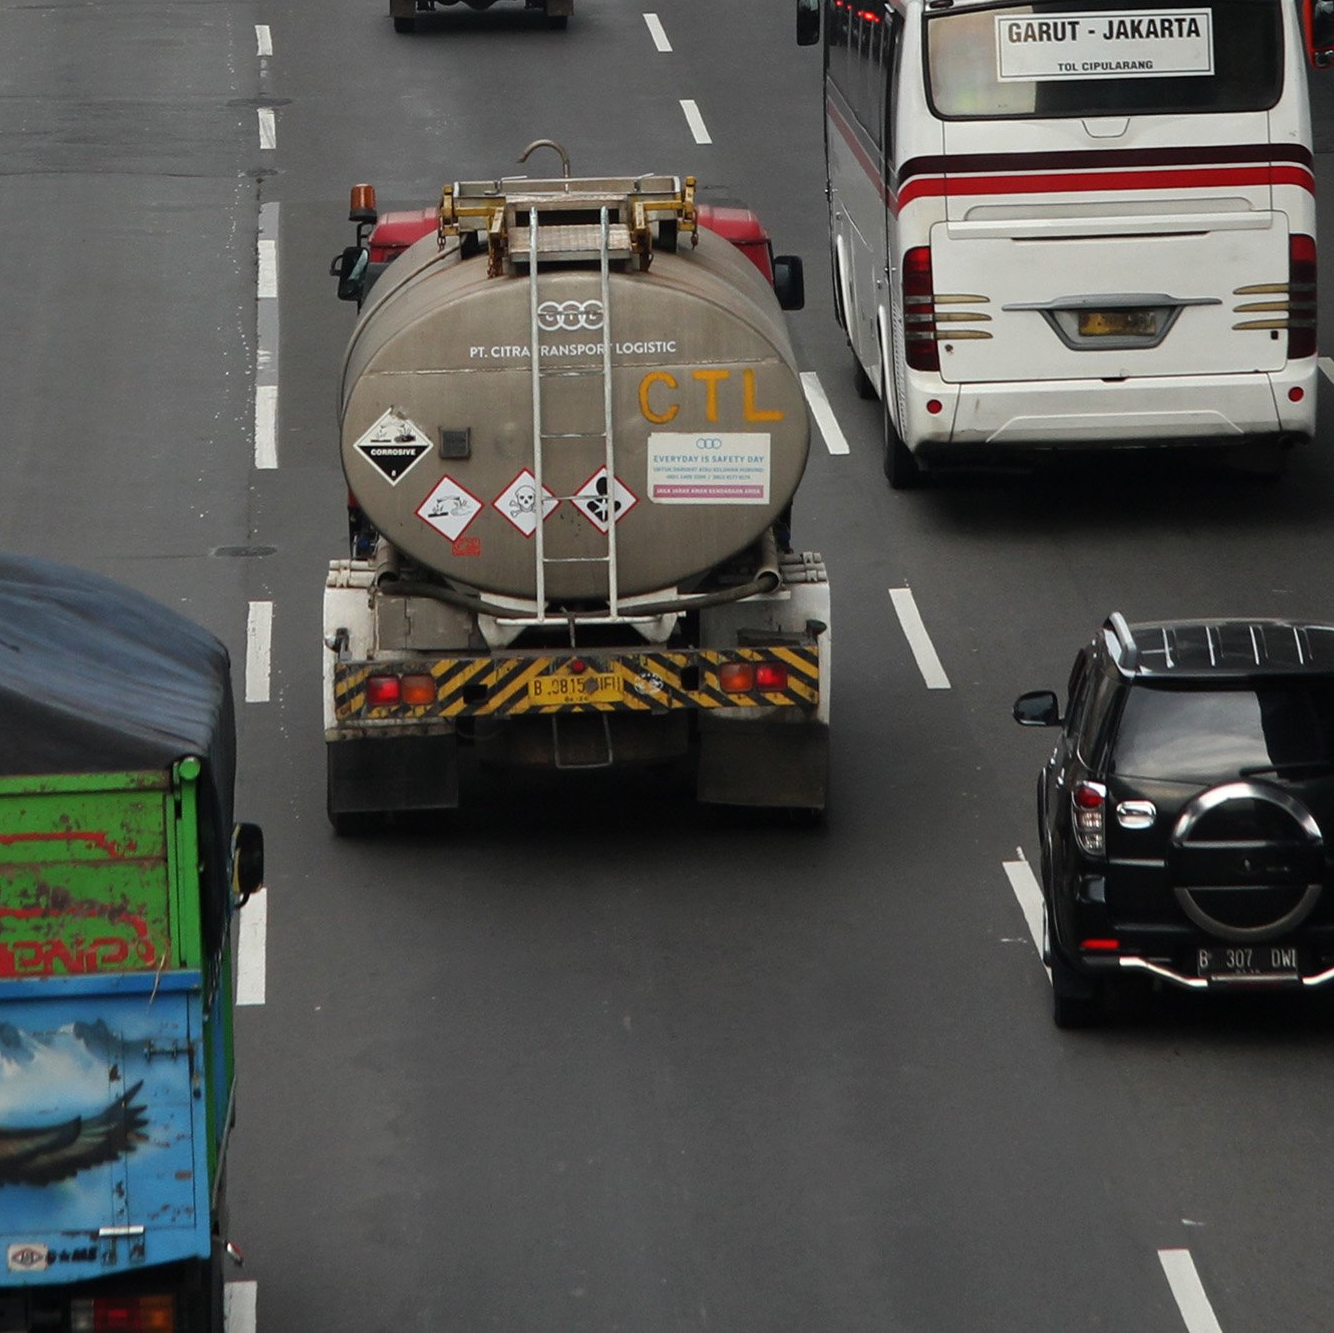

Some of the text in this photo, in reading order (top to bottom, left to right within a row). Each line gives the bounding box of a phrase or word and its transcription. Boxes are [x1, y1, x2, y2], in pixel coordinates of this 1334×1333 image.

[1008, 21, 1080, 44] GARUT
[1103, 17, 1201, 40] JAKARTA
[1057, 60, 1154, 72] TOL CIPULARANG
[470, 341, 677, 358] PT. CITRA RANSPOR LOGISTIC
[638, 368, 784, 424] CTL
[653, 455, 765, 463] EVERYDAY IS SAFETY DAY
[534, 680, 542, 696] B
[1199, 949, 1208, 968] B
[1226, 949, 1253, 968] 307
